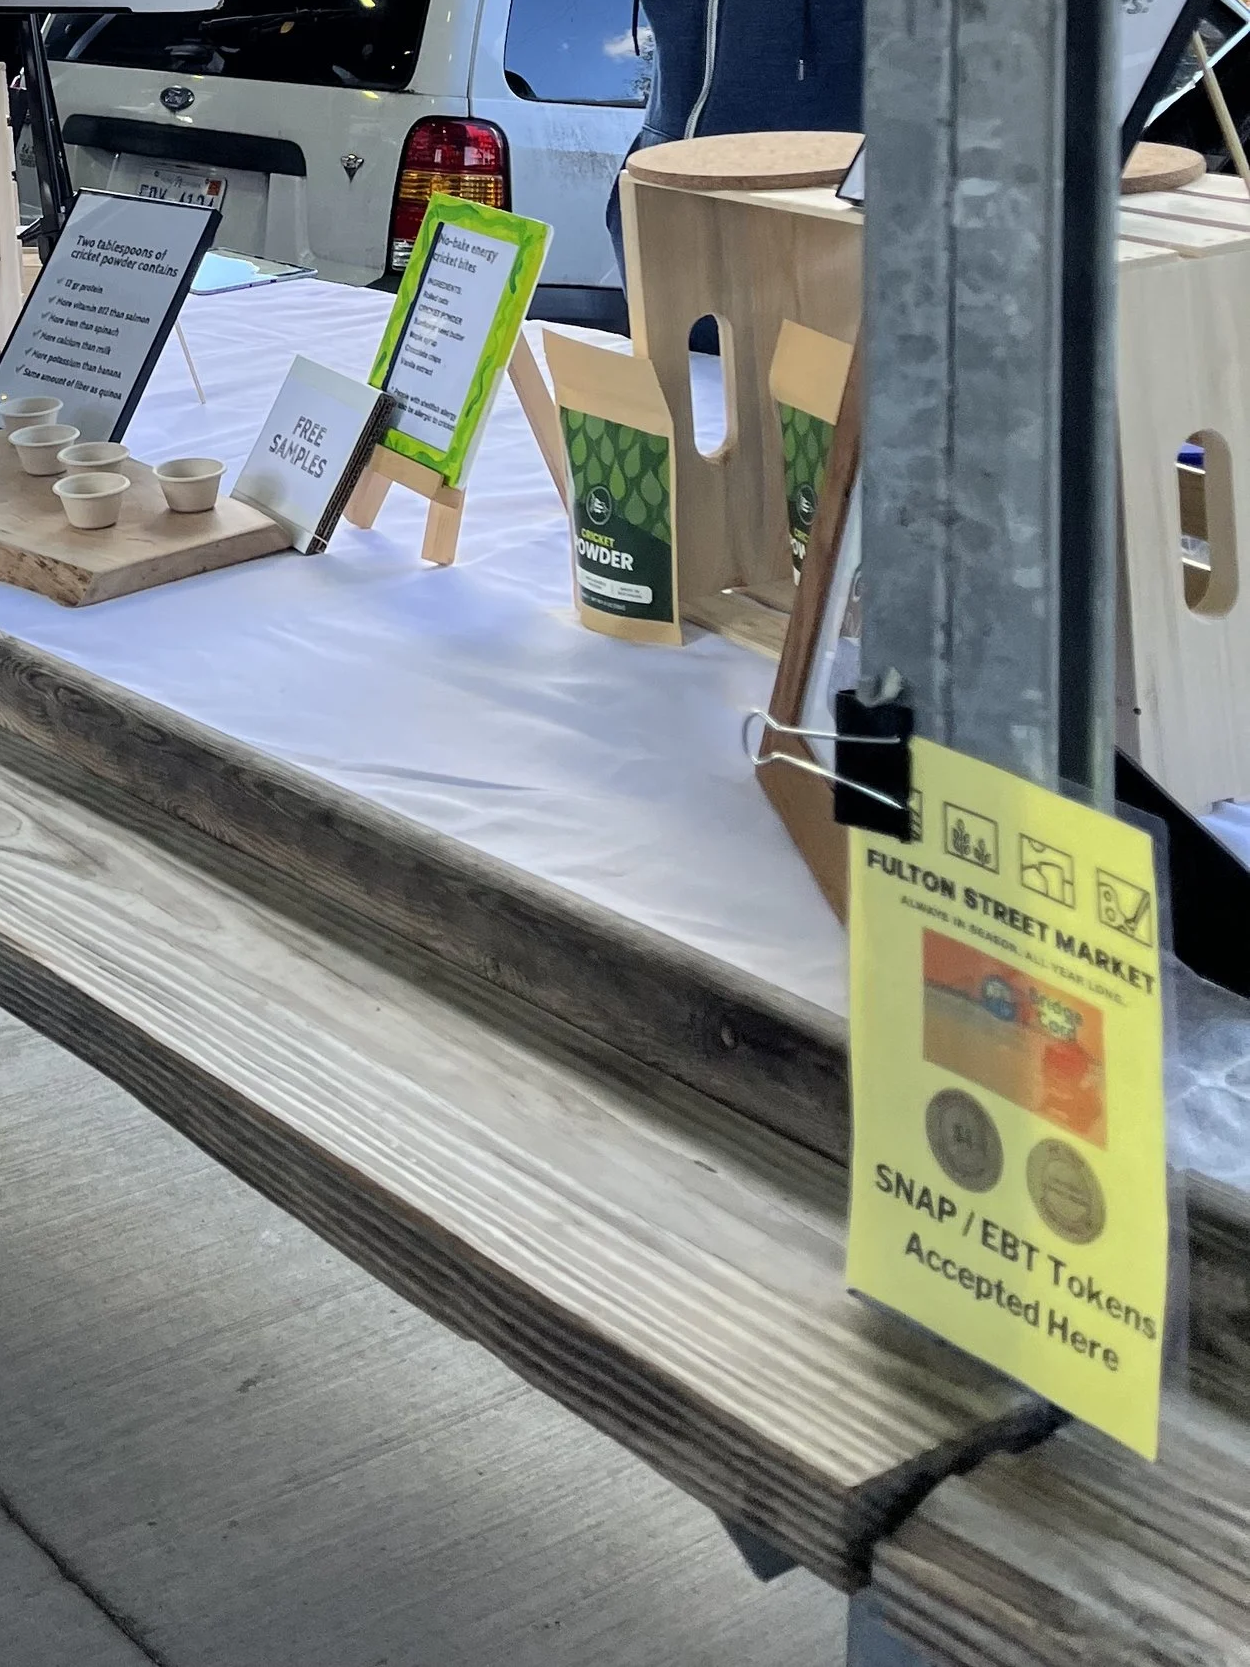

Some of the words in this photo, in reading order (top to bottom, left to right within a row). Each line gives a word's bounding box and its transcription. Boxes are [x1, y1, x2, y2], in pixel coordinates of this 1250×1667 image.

[77, 235, 95, 248] Two
[97, 239, 154, 258] tablespoons
[155, 249, 168, 261] of
[433, 252, 458, 267] cricket
[458, 258, 477, 273] bites
[439, 233, 470, 252] No-bake
[471, 246, 499, 264] energy
[71, 249, 101, 262] cricket
[99, 255, 138, 270] powder
[138, 263, 179, 277] contains
[79, 283, 103, 294] protein
[48, 314, 64, 324] More
[65, 316, 78, 327] iron
[79, 320, 93, 331] than
[94, 324, 120, 337] spinach
[56, 298, 72, 307] More
[74, 301, 96, 312] vitamin
[110, 308, 124, 319] than
[125, 313, 150, 324] salmon
[40, 332, 55, 342] More
[56, 336, 80, 348] calcium
[81, 341, 96, 352] than
[96, 344, 111, 355] milk
[31, 350, 47, 360] More
[46, 353, 81, 369] potassium
[82, 361, 97, 373] than
[97, 366, 121, 379] banana
[22, 368, 40, 379] Same
[41, 372, 67, 385] amount
[66, 378, 75, 387] of
[74, 380, 90, 391] fiber
[90, 384, 98, 394] as
[98, 388, 122, 400] quinoa
[292, 415, 328, 448] FREE
[269, 434, 328, 478] SAMPLES
[581, 528, 616, 548] CRICKET
[867, 847, 956, 901] FULTON
[964, 885, 1050, 943] STREET
[1055, 928, 1156, 995] MARKET
[900, 895, 950, 923] ALWAYS
[953, 916, 967, 930] IN
[1025, 951, 1047, 967] ALL
[1050, 961, 1084, 985] YEAR
[876, 1163, 957, 1224] SNAP
[962, 1211, 975, 1237] /
[981, 1218, 1040, 1272] EBT
[1048, 1254, 1157, 1340] Tokens
[905, 1231, 1040, 1328] Accepted
[1048, 1308, 1120, 1372] Here
